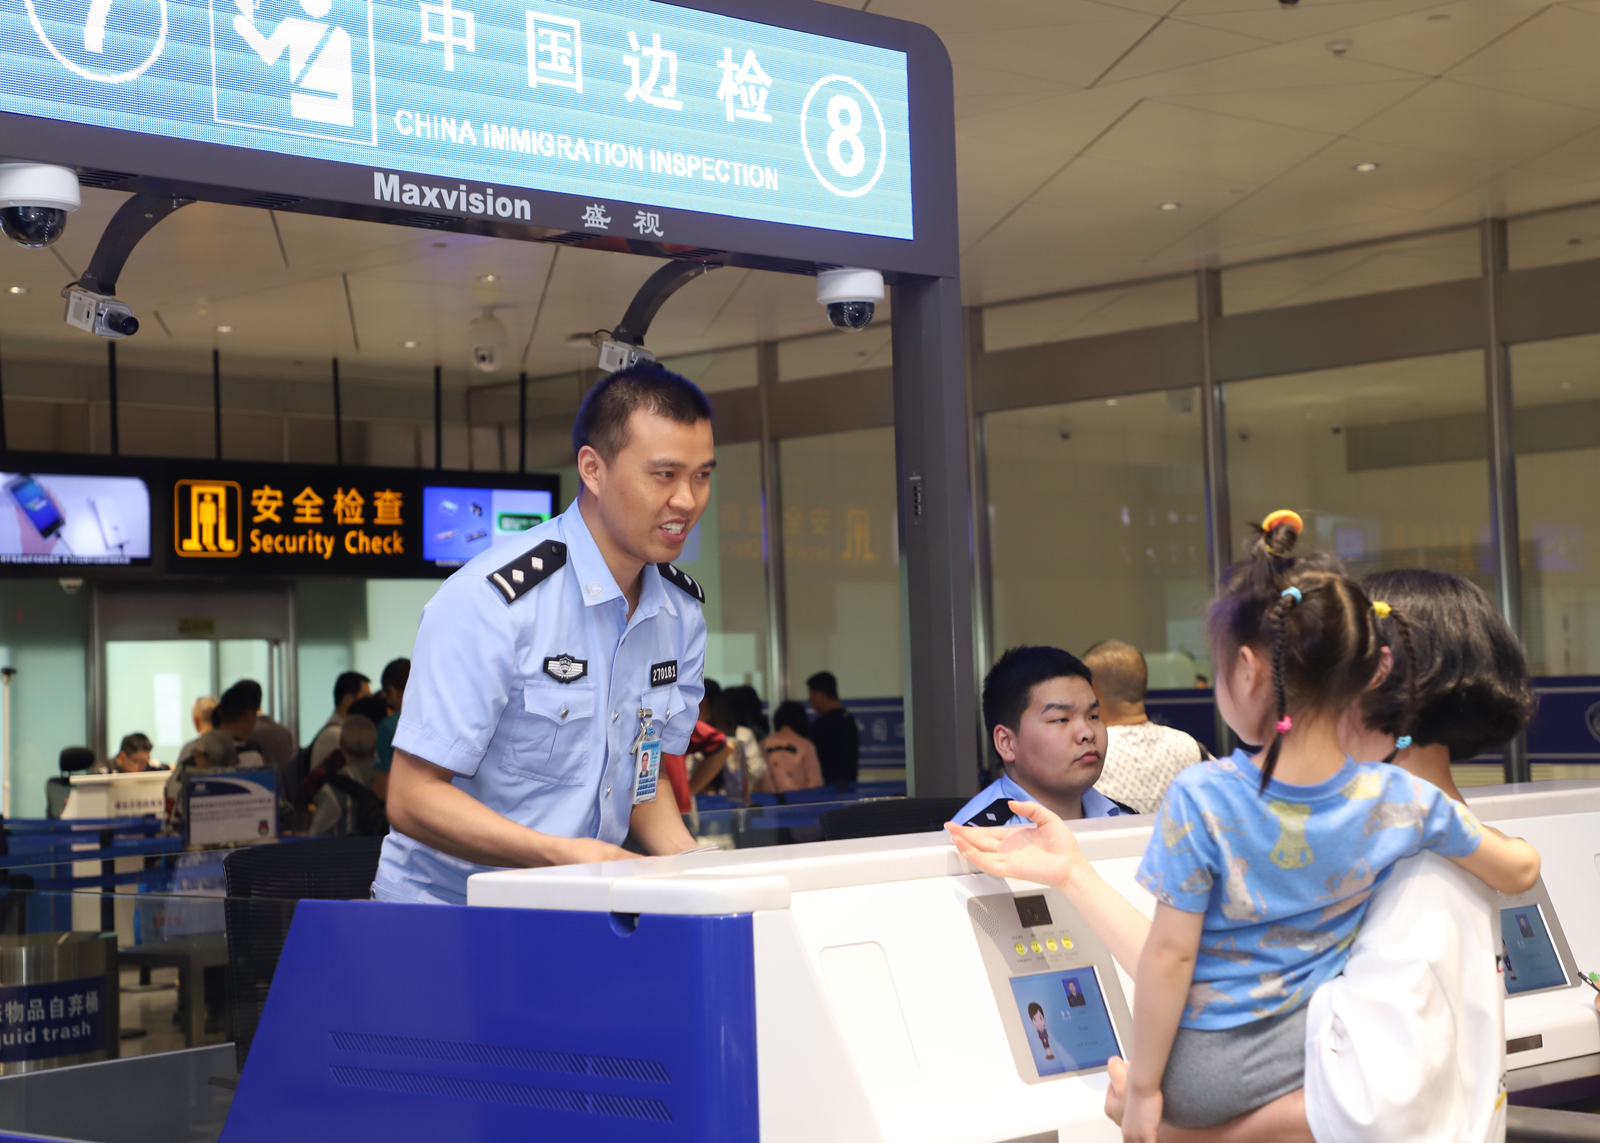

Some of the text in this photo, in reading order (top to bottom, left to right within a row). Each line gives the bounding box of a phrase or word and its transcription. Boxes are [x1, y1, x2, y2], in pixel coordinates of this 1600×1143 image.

[419, 0, 773, 123] 中国边检
[394, 110, 779, 191] CHINA IMMIGRATION INSPECTION
[826, 94, 865, 177] 8
[373, 172, 532, 220] Maxvision
[581, 203, 665, 238] 盛视
[250, 484, 404, 526] 安全检查
[249, 528, 405, 560] Security Check
[652, 665, 677, 682] 270181
[0, 991, 99, 1024] 物品自弃桶
[0, 1020, 91, 1050] uid trash
